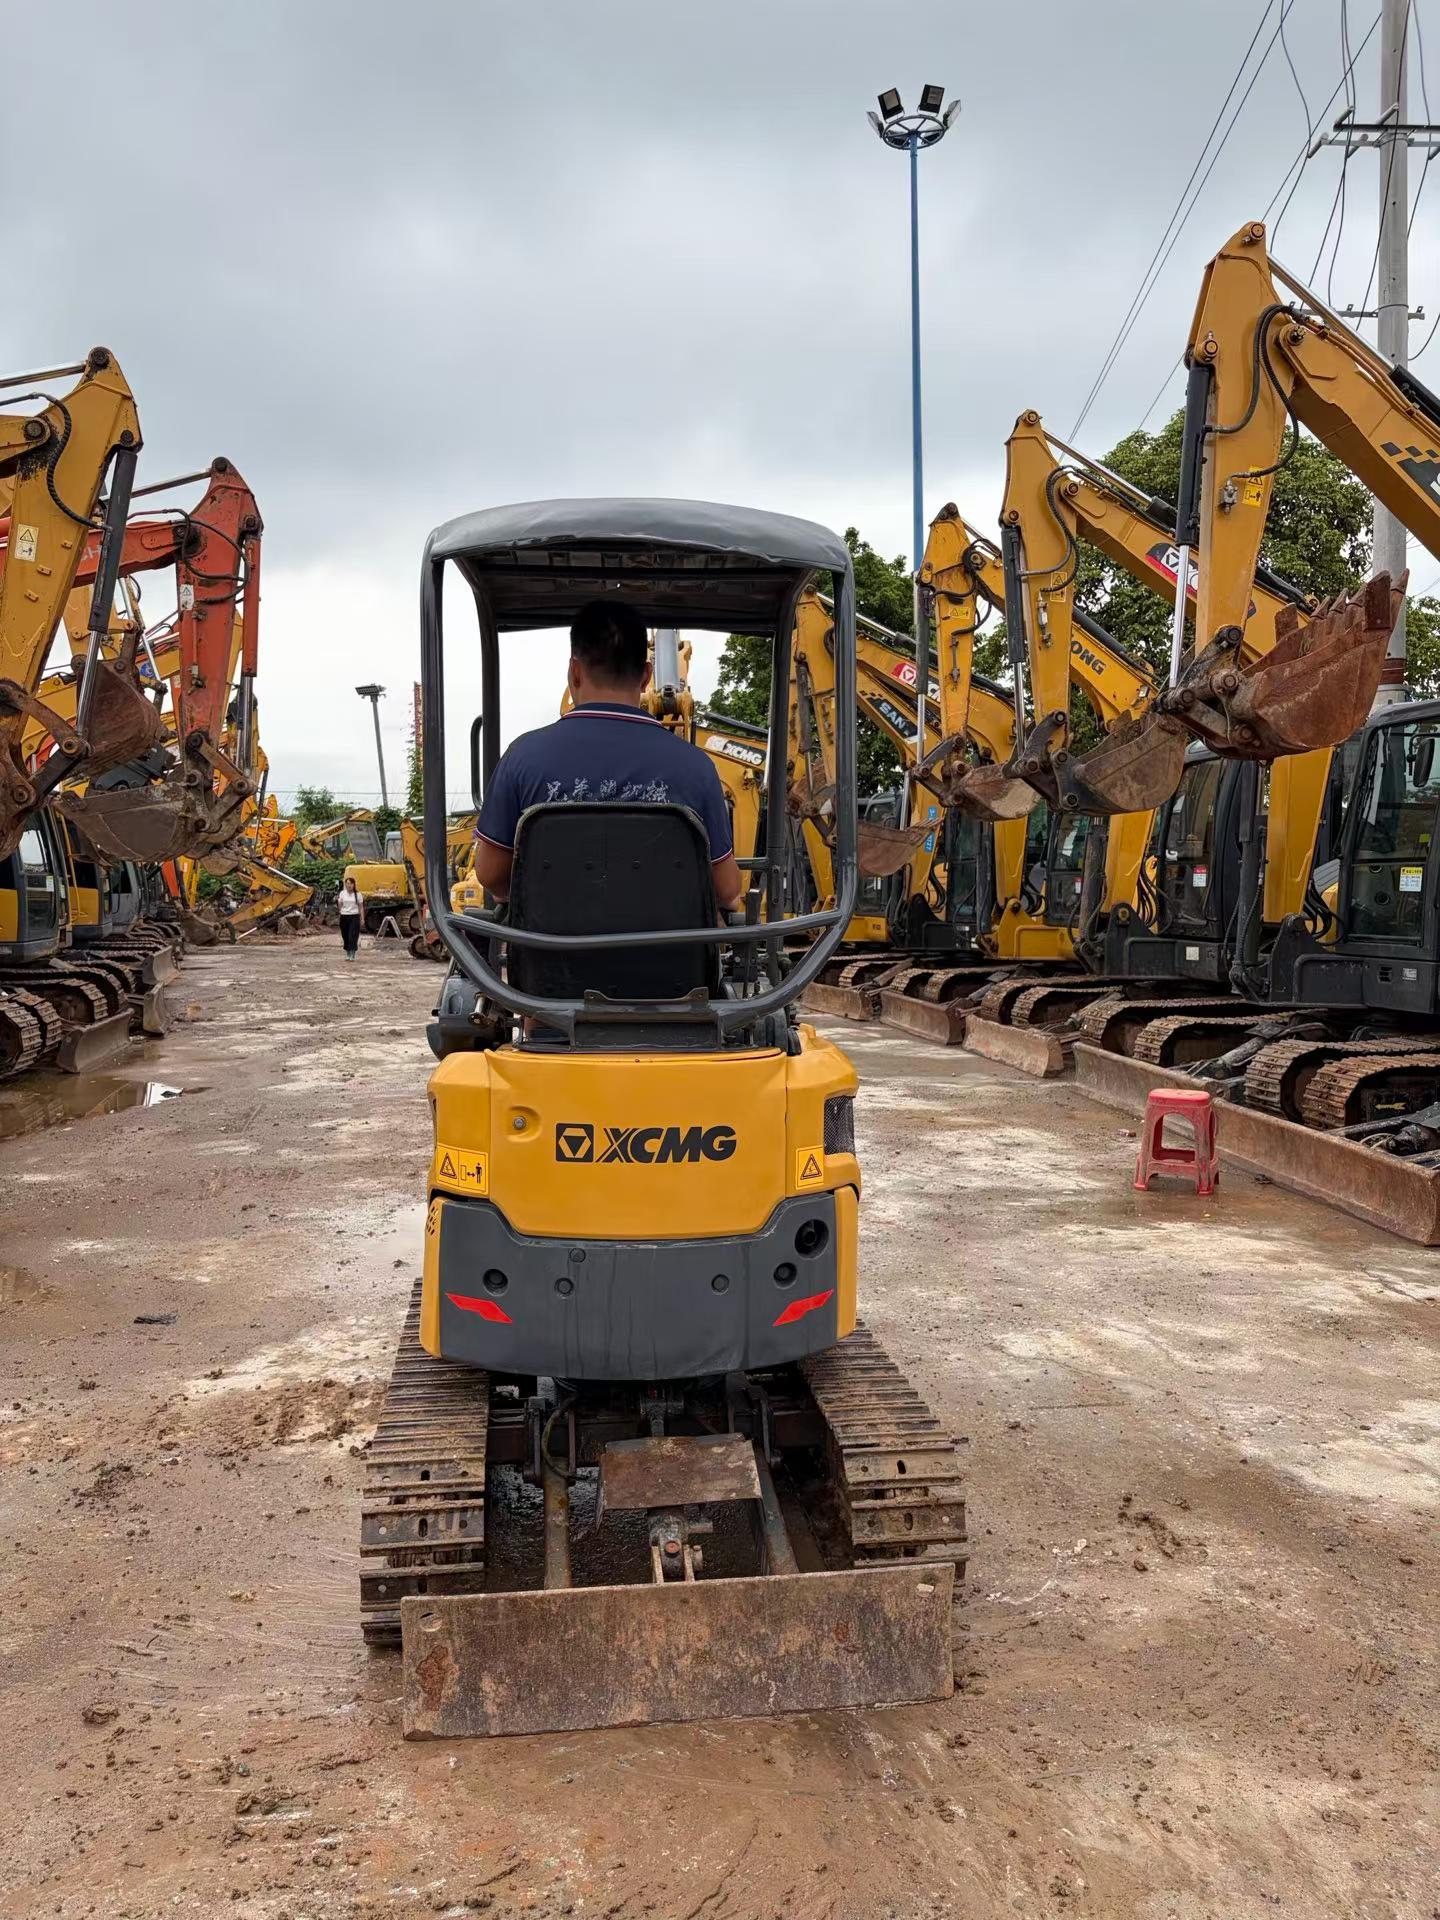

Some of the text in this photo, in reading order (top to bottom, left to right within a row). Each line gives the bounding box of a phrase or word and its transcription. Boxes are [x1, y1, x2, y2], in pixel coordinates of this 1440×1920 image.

[879, 702, 909, 737] SAN
[722, 742, 762, 765] XCMG
[595, 1125, 737, 1163] XCMG
